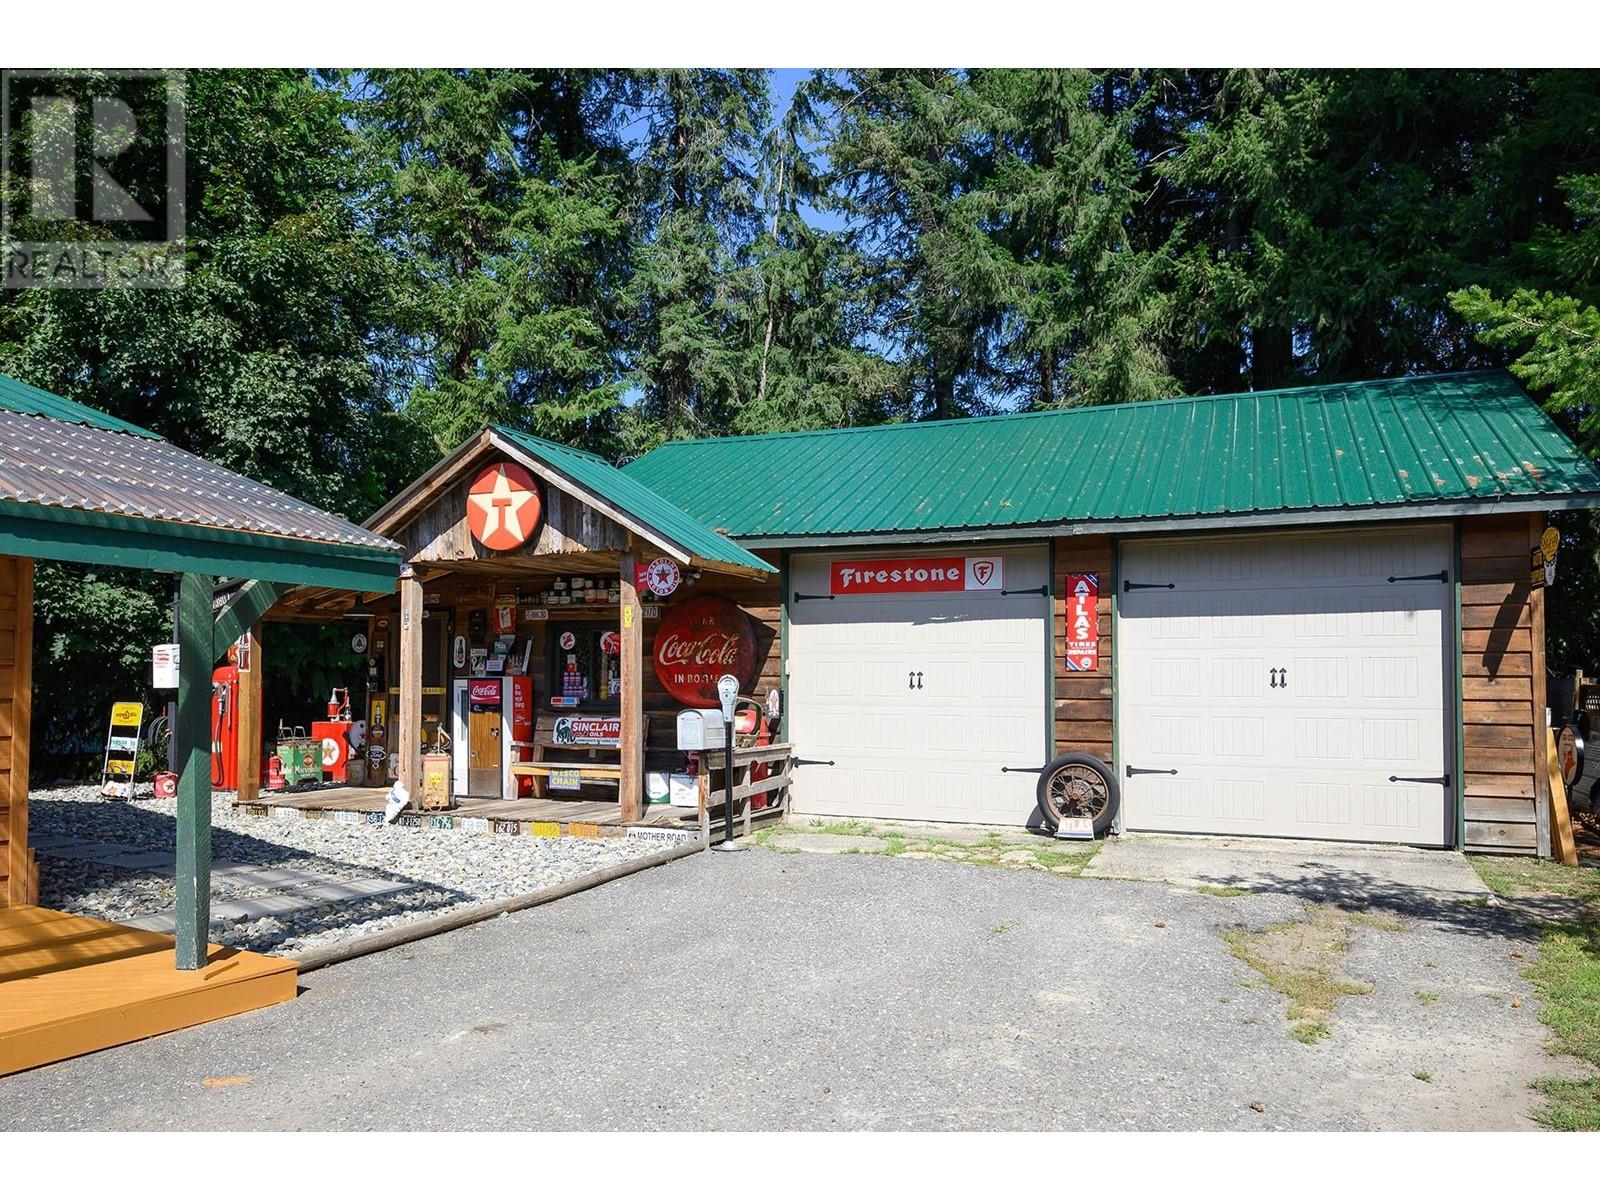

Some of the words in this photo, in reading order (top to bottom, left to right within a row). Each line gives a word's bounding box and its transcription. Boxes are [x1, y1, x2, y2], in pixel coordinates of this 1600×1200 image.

[839, 565, 960, 589] Firestone
[1073, 579, 1091, 640] ATLAS
[658, 632, 740, 666] Coca-Cola
[674, 673, 685, 684] IN
[472, 684, 498, 697] Coca-Cola
[572, 722, 620, 732] SINCLAIR
[551, 778, 578, 786] CHAIN
[637, 831, 666, 841] MOTHER
[666, 833, 687, 842] ROAD
